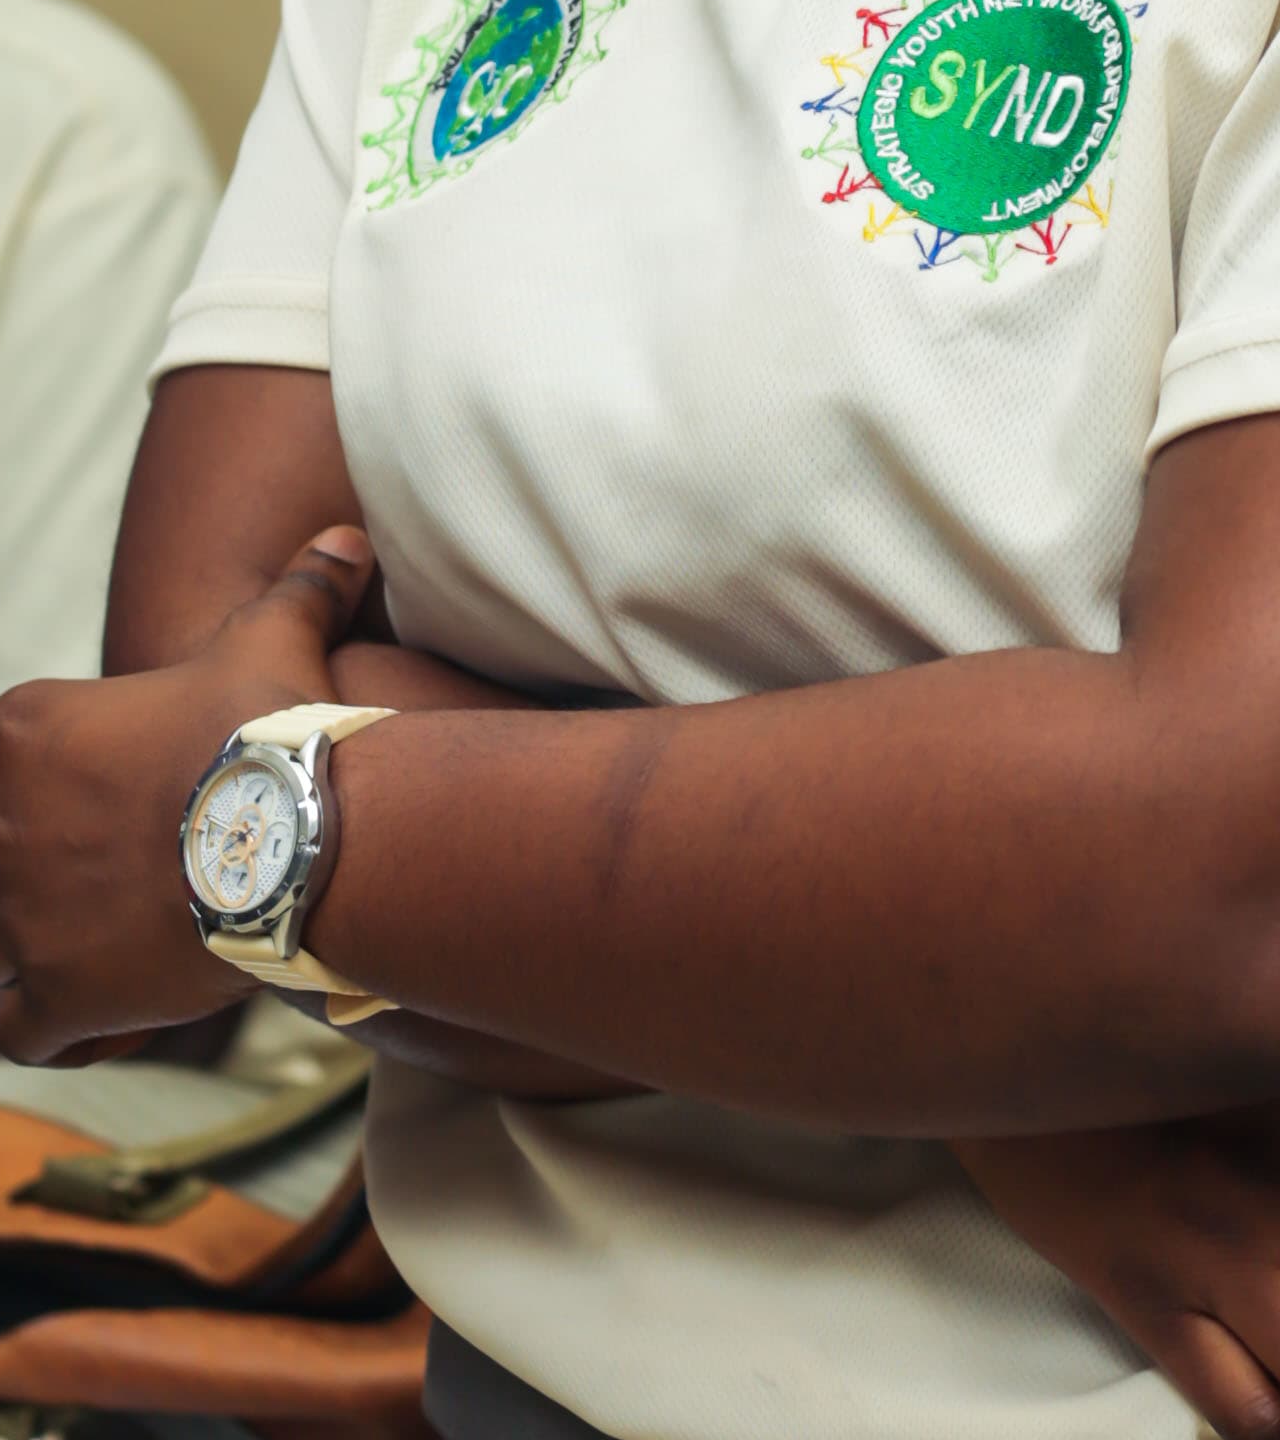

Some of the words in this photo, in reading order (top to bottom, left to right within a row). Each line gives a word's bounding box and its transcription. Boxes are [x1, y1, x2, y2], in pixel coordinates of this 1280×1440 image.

[1088, 14, 1123, 68] FOR
[871, 72, 935, 200] STRATEGIC
[910, 50, 1087, 148] SYND
[982, 64, 1123, 222] DEVELOPMENT
